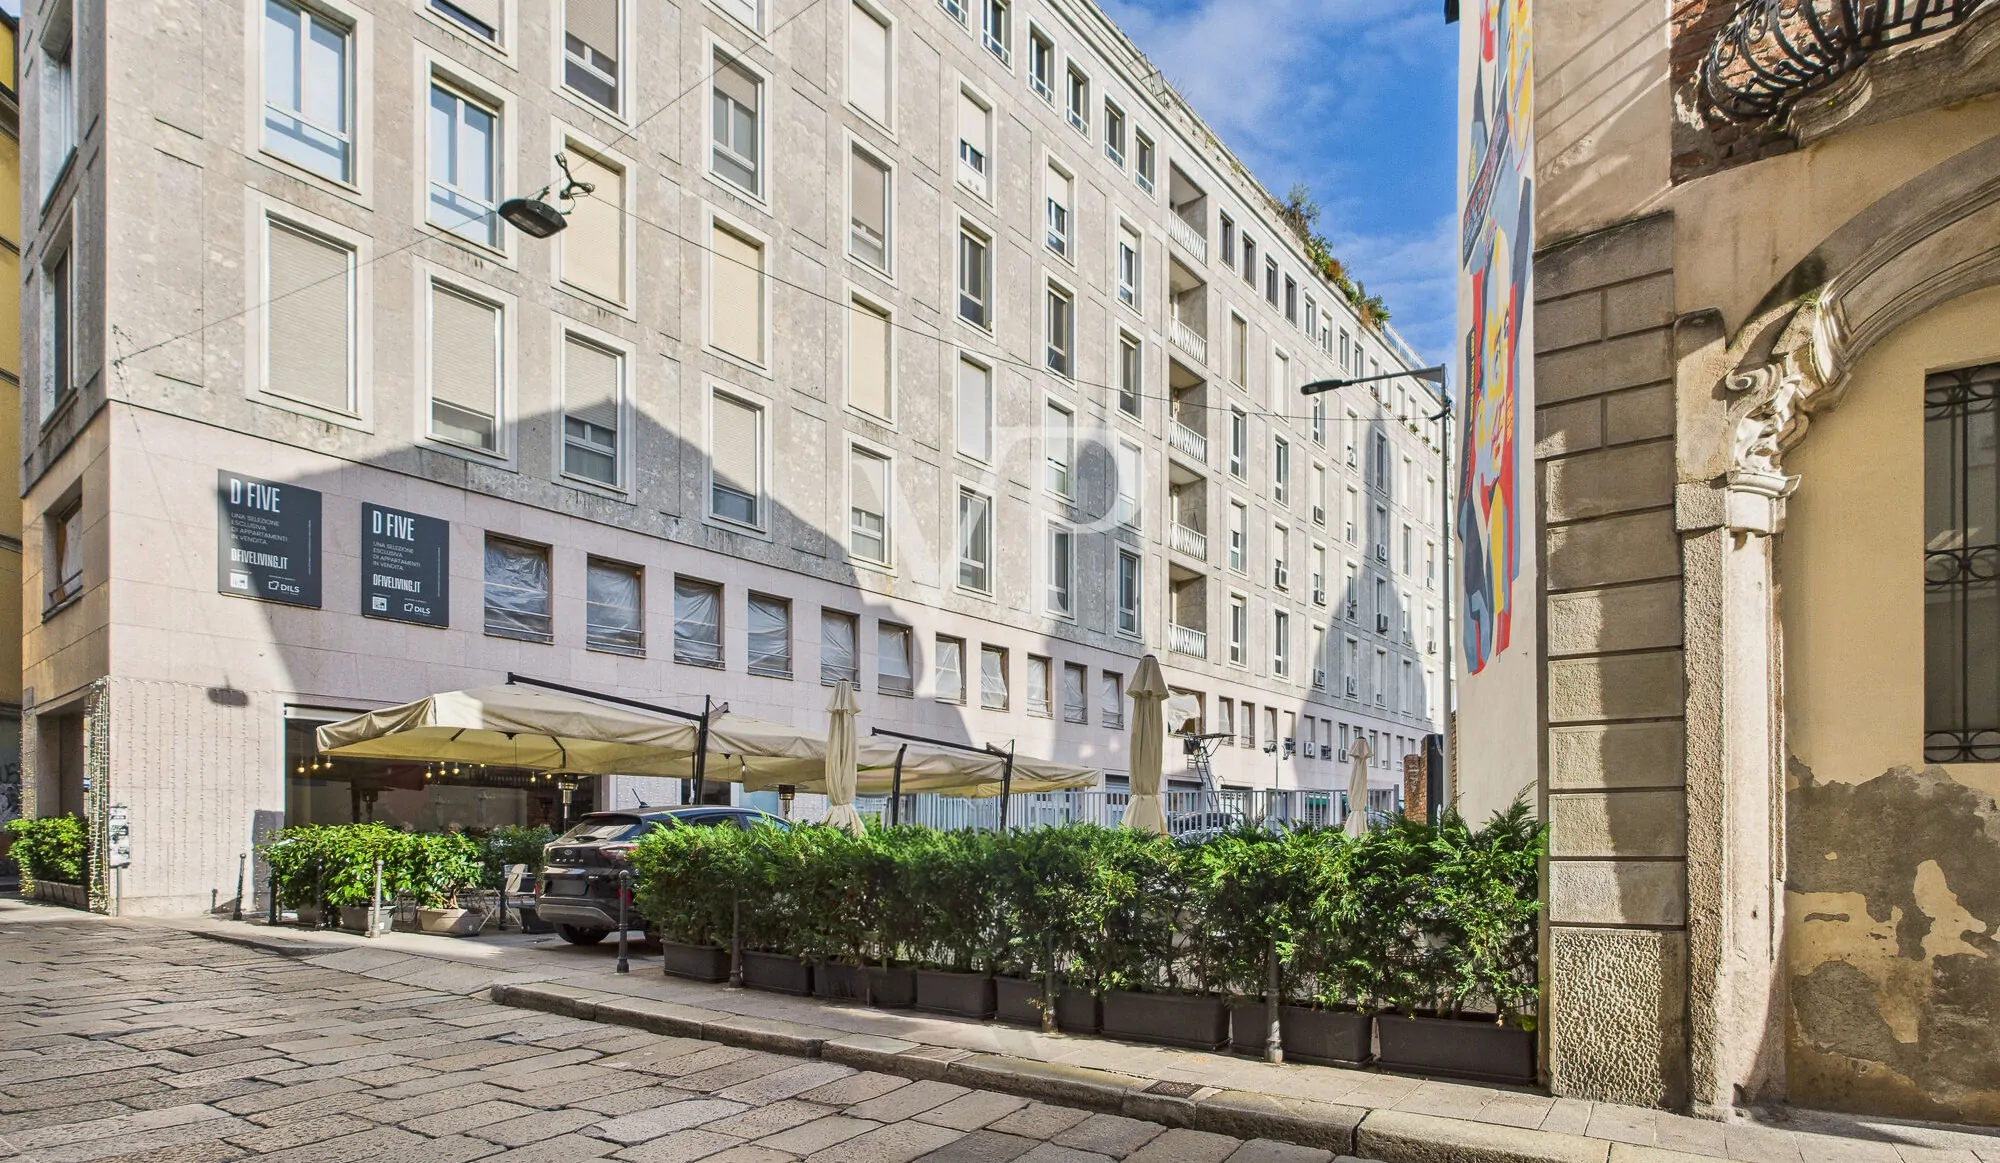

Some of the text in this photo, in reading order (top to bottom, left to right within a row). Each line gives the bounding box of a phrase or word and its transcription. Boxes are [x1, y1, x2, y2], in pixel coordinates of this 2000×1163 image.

[230, 478, 280, 513] D FIVE
[230, 512, 280, 528] UNA SELEZIONE
[230, 519, 267, 532] ESCLUSIVA
[373, 510, 415, 541] D FIVE
[230, 533, 239, 541] IN
[239, 528, 288, 542] APPARTAMENTI
[373, 547, 403, 558] ESCLUSIVA
[386, 543, 414, 554] SELEZIONE
[230, 547, 289, 571] DFIVELIVING.IT
[380, 555, 421, 568] APPARTAMENTI
[280, 583, 300, 594] DILS
[372, 573, 421, 593] DFIVELIVING.IT
[414, 605, 431, 614] DILS
